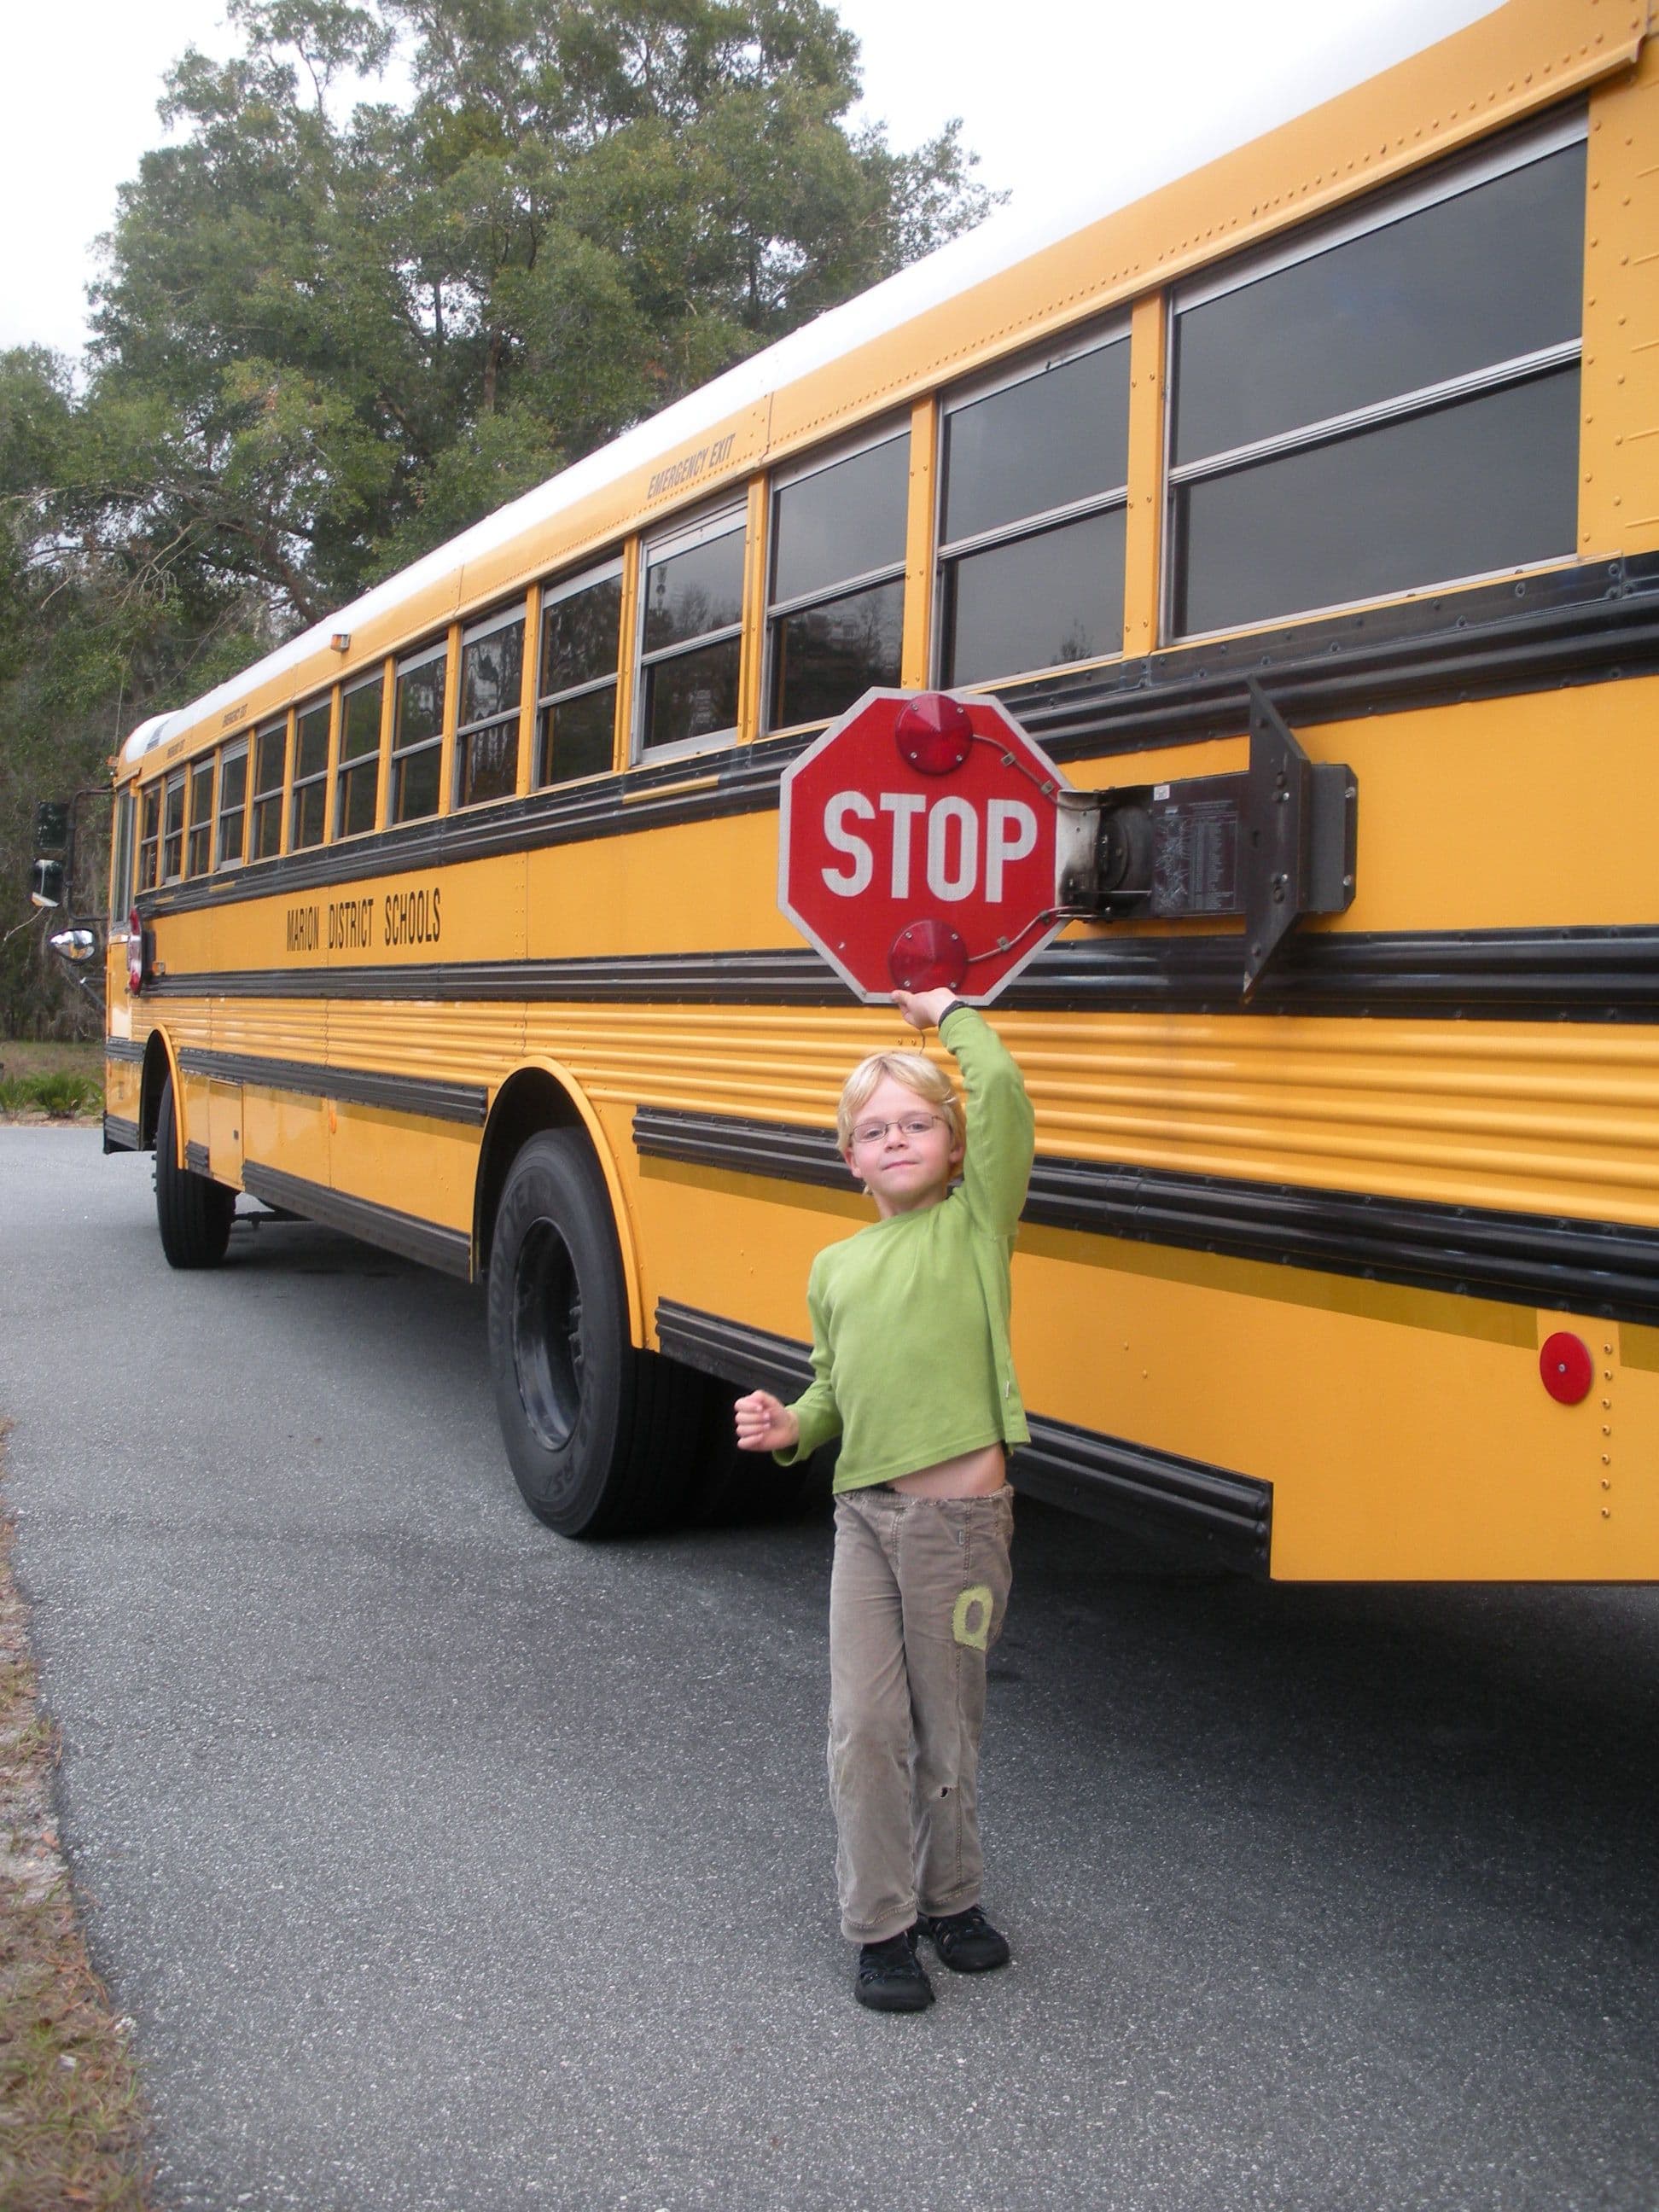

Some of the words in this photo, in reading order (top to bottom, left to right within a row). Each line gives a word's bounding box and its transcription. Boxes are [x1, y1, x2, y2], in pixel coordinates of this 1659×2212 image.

[648, 446, 709, 500] EMERGENCY
[709, 433, 736, 469] EXIT
[821, 790, 1038, 903] STOP
[287, 906, 319, 952] MARION
[329, 899, 374, 949] DISTRICT
[385, 888, 440, 946] SCHOOLS
